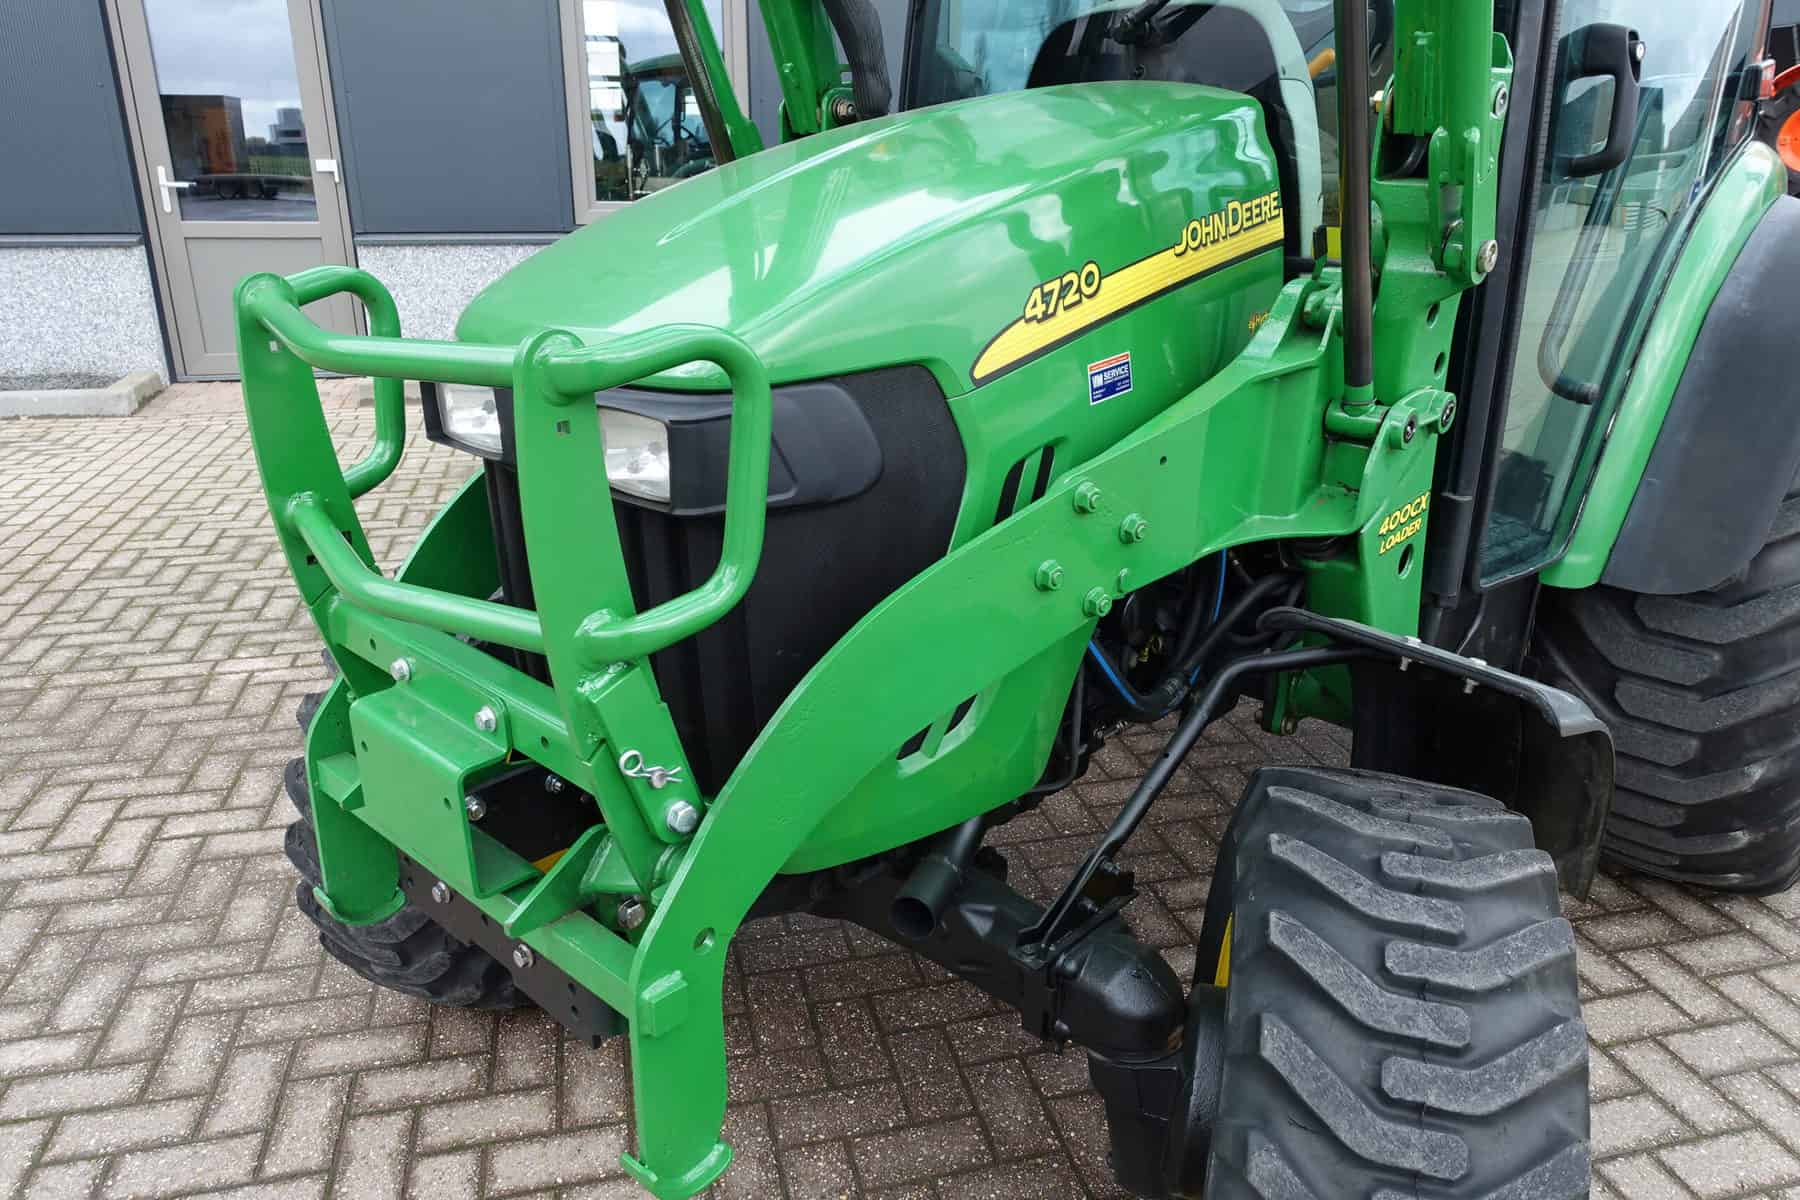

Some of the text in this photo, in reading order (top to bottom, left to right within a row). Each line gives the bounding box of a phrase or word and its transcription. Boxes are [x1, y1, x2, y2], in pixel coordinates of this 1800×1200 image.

[1174, 190, 1280, 255] JOHN DEERE
[1024, 261, 1101, 323] 4720
[1103, 364, 1129, 381] SERVICE
[1379, 491, 1431, 535] 400CX
[1379, 518, 1422, 555] LOADER
